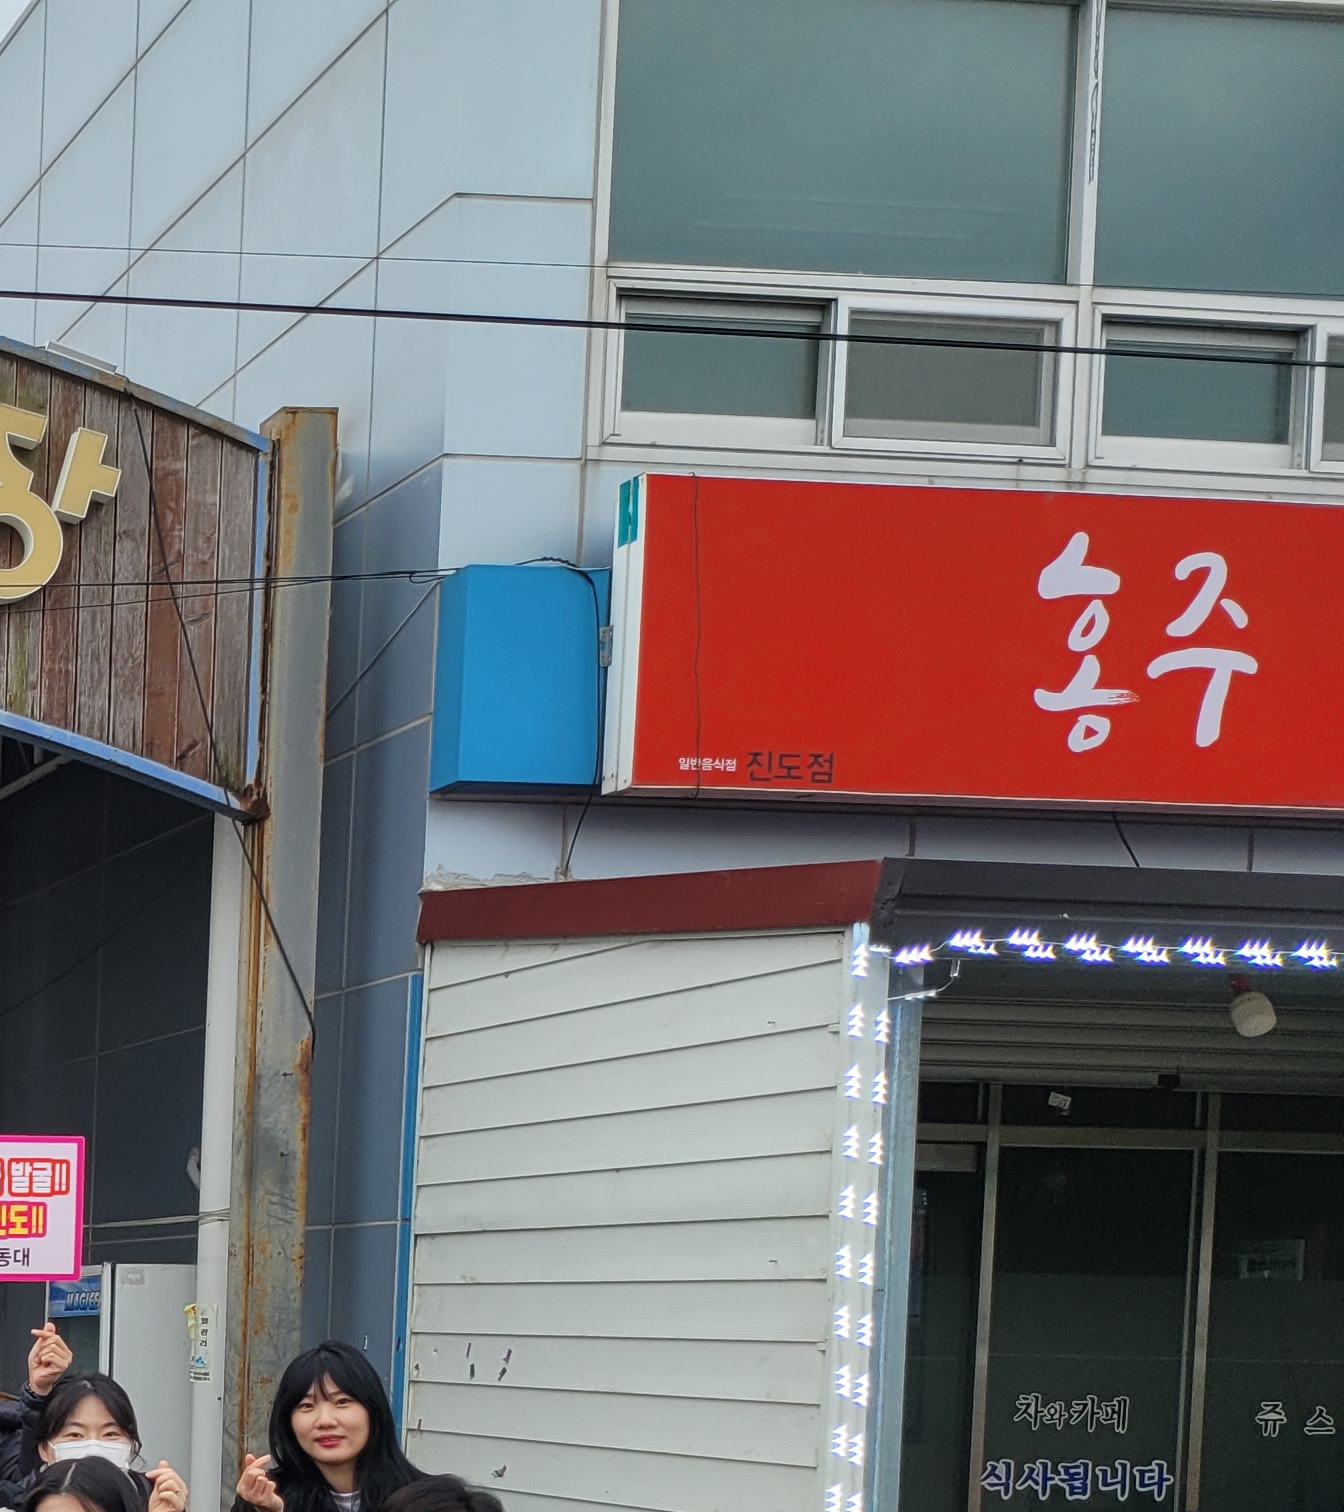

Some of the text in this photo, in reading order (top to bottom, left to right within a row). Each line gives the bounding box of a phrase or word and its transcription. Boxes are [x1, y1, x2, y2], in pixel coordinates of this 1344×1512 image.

[678, 750, 836, 785] 일반음식점 진도점
[9, 1158, 70, 1196] 발굴!!
[1013, 1393, 1130, 1434] 차와카페
[980, 1459, 1174, 1501] 식사됩니다
